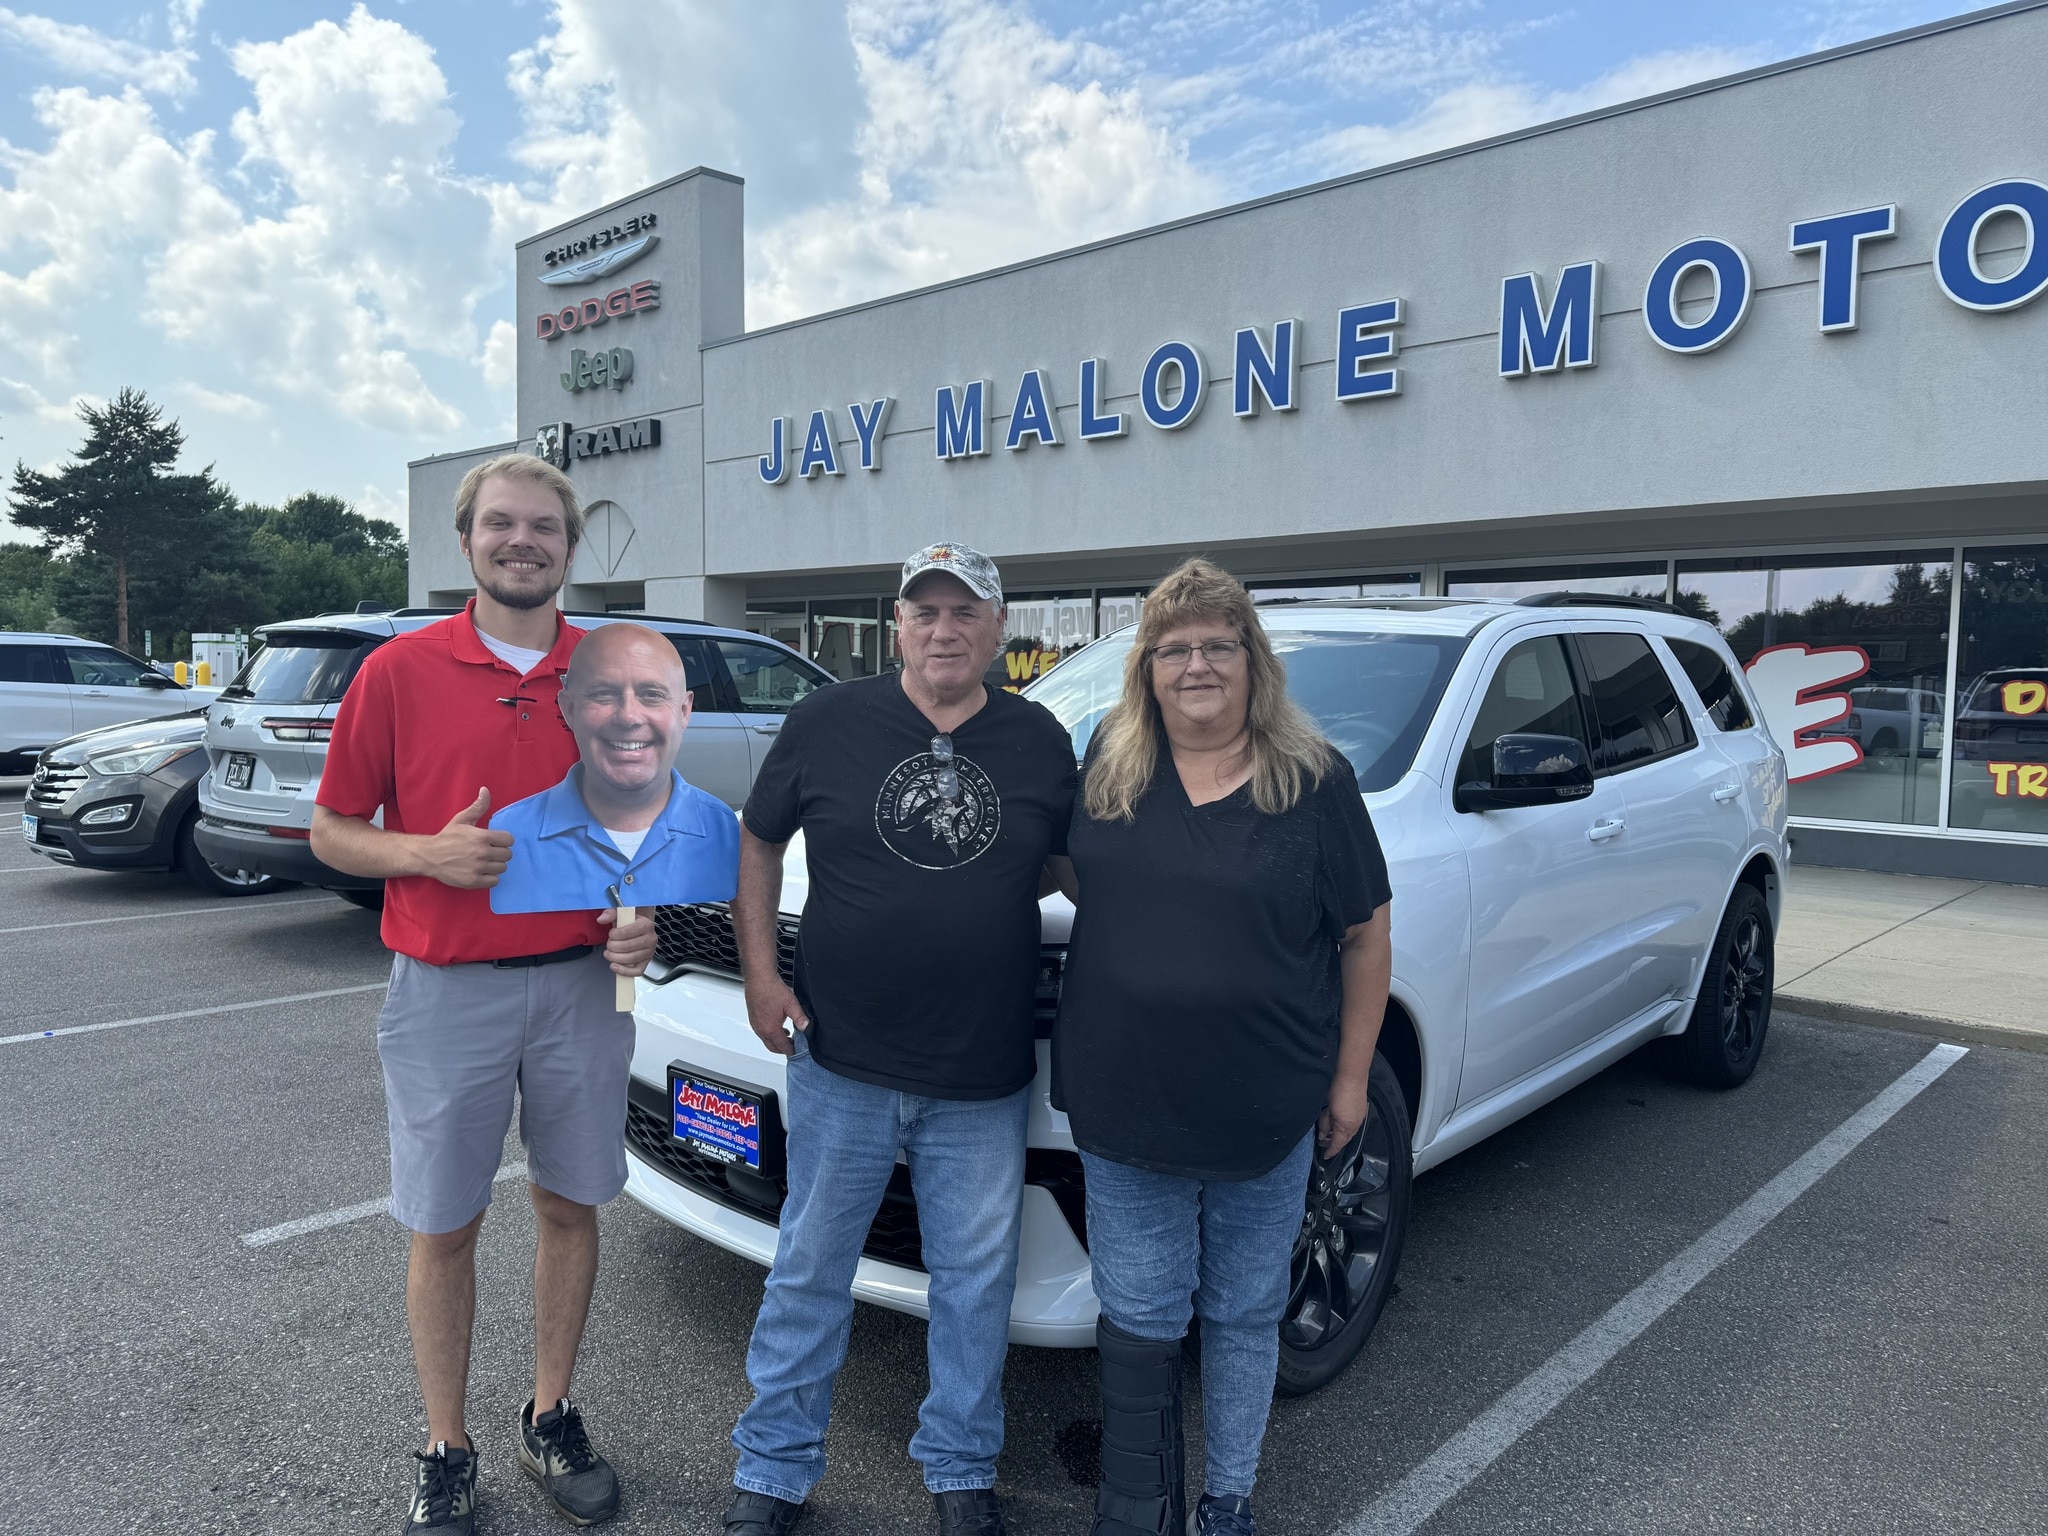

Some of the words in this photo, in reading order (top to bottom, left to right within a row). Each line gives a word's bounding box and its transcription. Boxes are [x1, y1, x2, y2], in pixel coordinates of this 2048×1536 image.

[542, 213, 657, 266] CHRYSLER
[537, 279, 660, 340] DODGE
[758, 397, 896, 486] JAY
[935, 297, 1406, 461] MALONE
[1498, 176, 2048, 379] MOTO
[560, 347, 634, 393] Jeep
[568, 418, 661, 461] RAM
[881, 757, 938, 819] MINNESOT
[950, 759, 996, 849] IMBERWOLVES
[678, 1085, 703, 1110] JAY
[703, 1094, 756, 1127] MALONE
